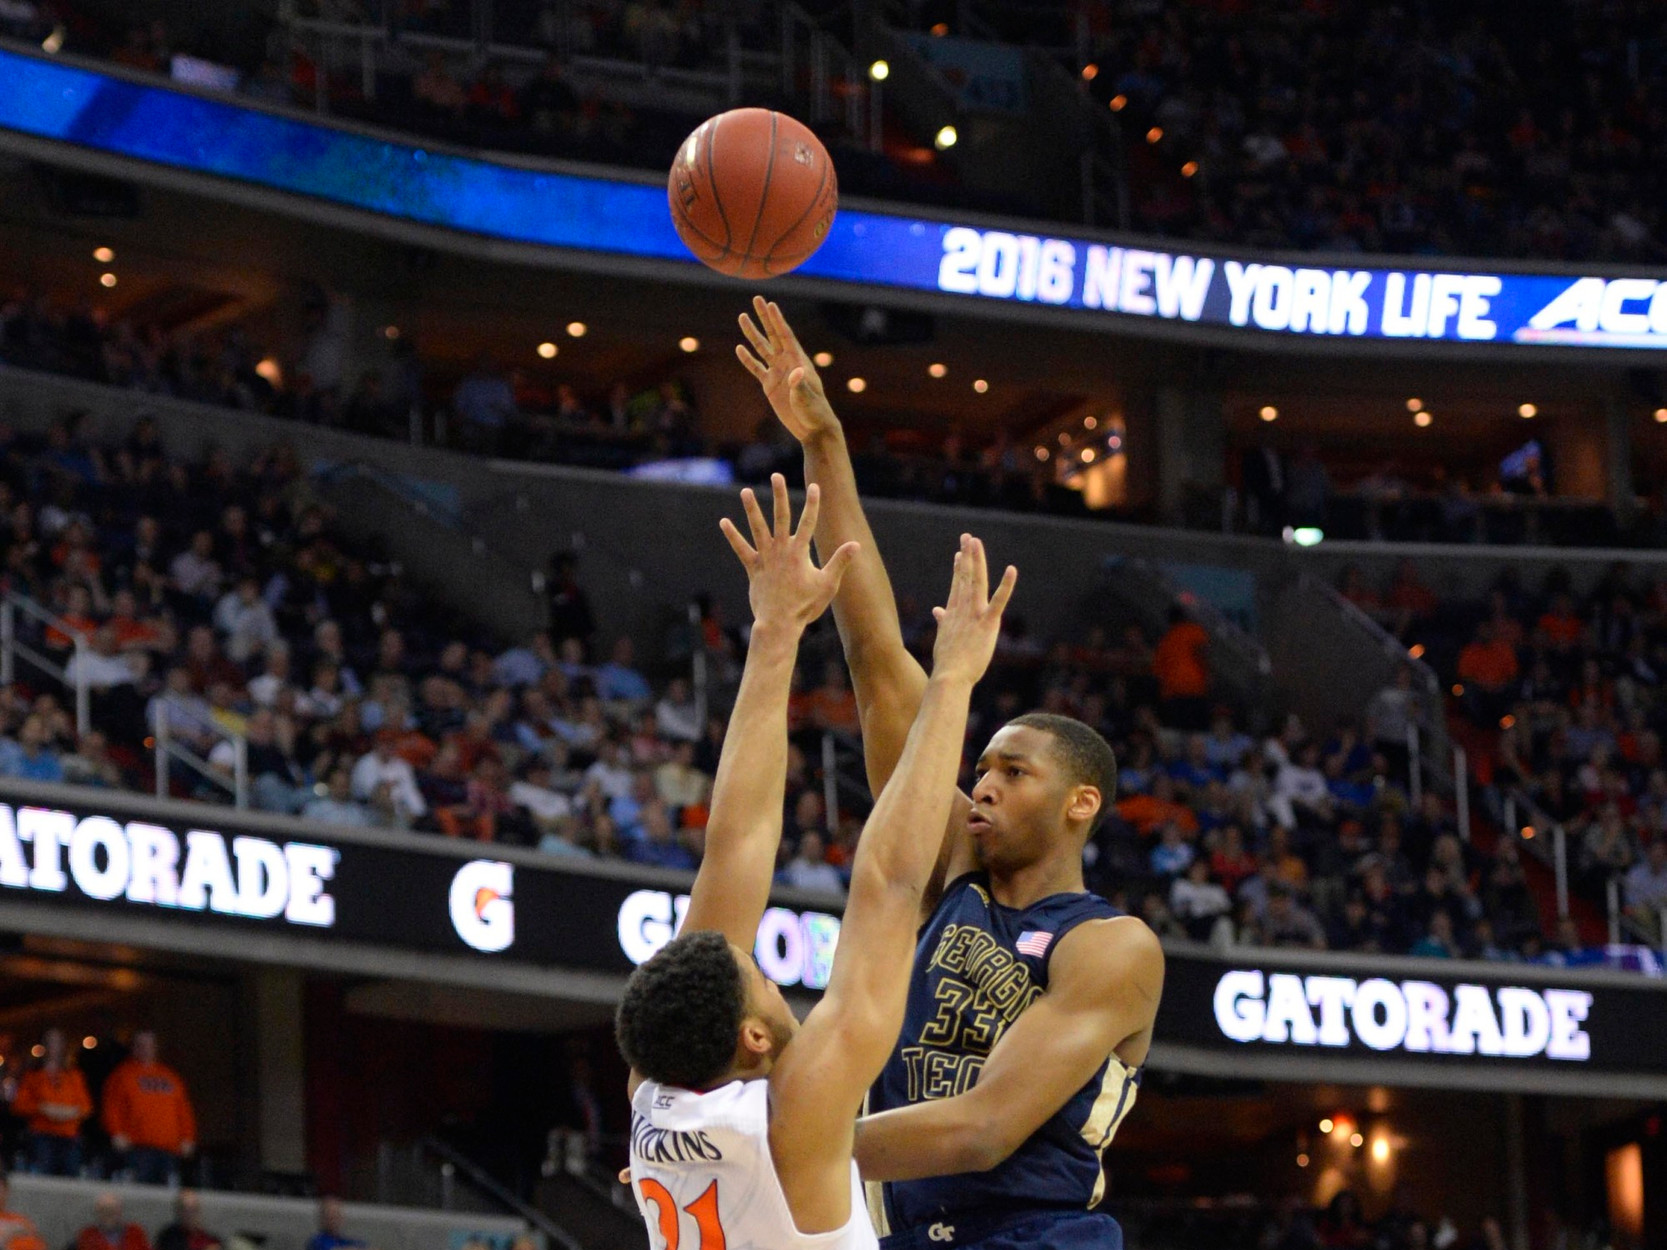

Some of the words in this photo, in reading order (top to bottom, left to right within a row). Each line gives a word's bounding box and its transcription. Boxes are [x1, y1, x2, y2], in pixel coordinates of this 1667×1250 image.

[938, 227, 1076, 305] 2016
[1083, 245, 1215, 321] NEW
[1224, 261, 1372, 335] YORK
[1381, 272, 1502, 340] LIFE
[449, 859, 515, 953] G
[919, 977, 1006, 1054] 33
[1214, 970, 1593, 1061] GATORADE
